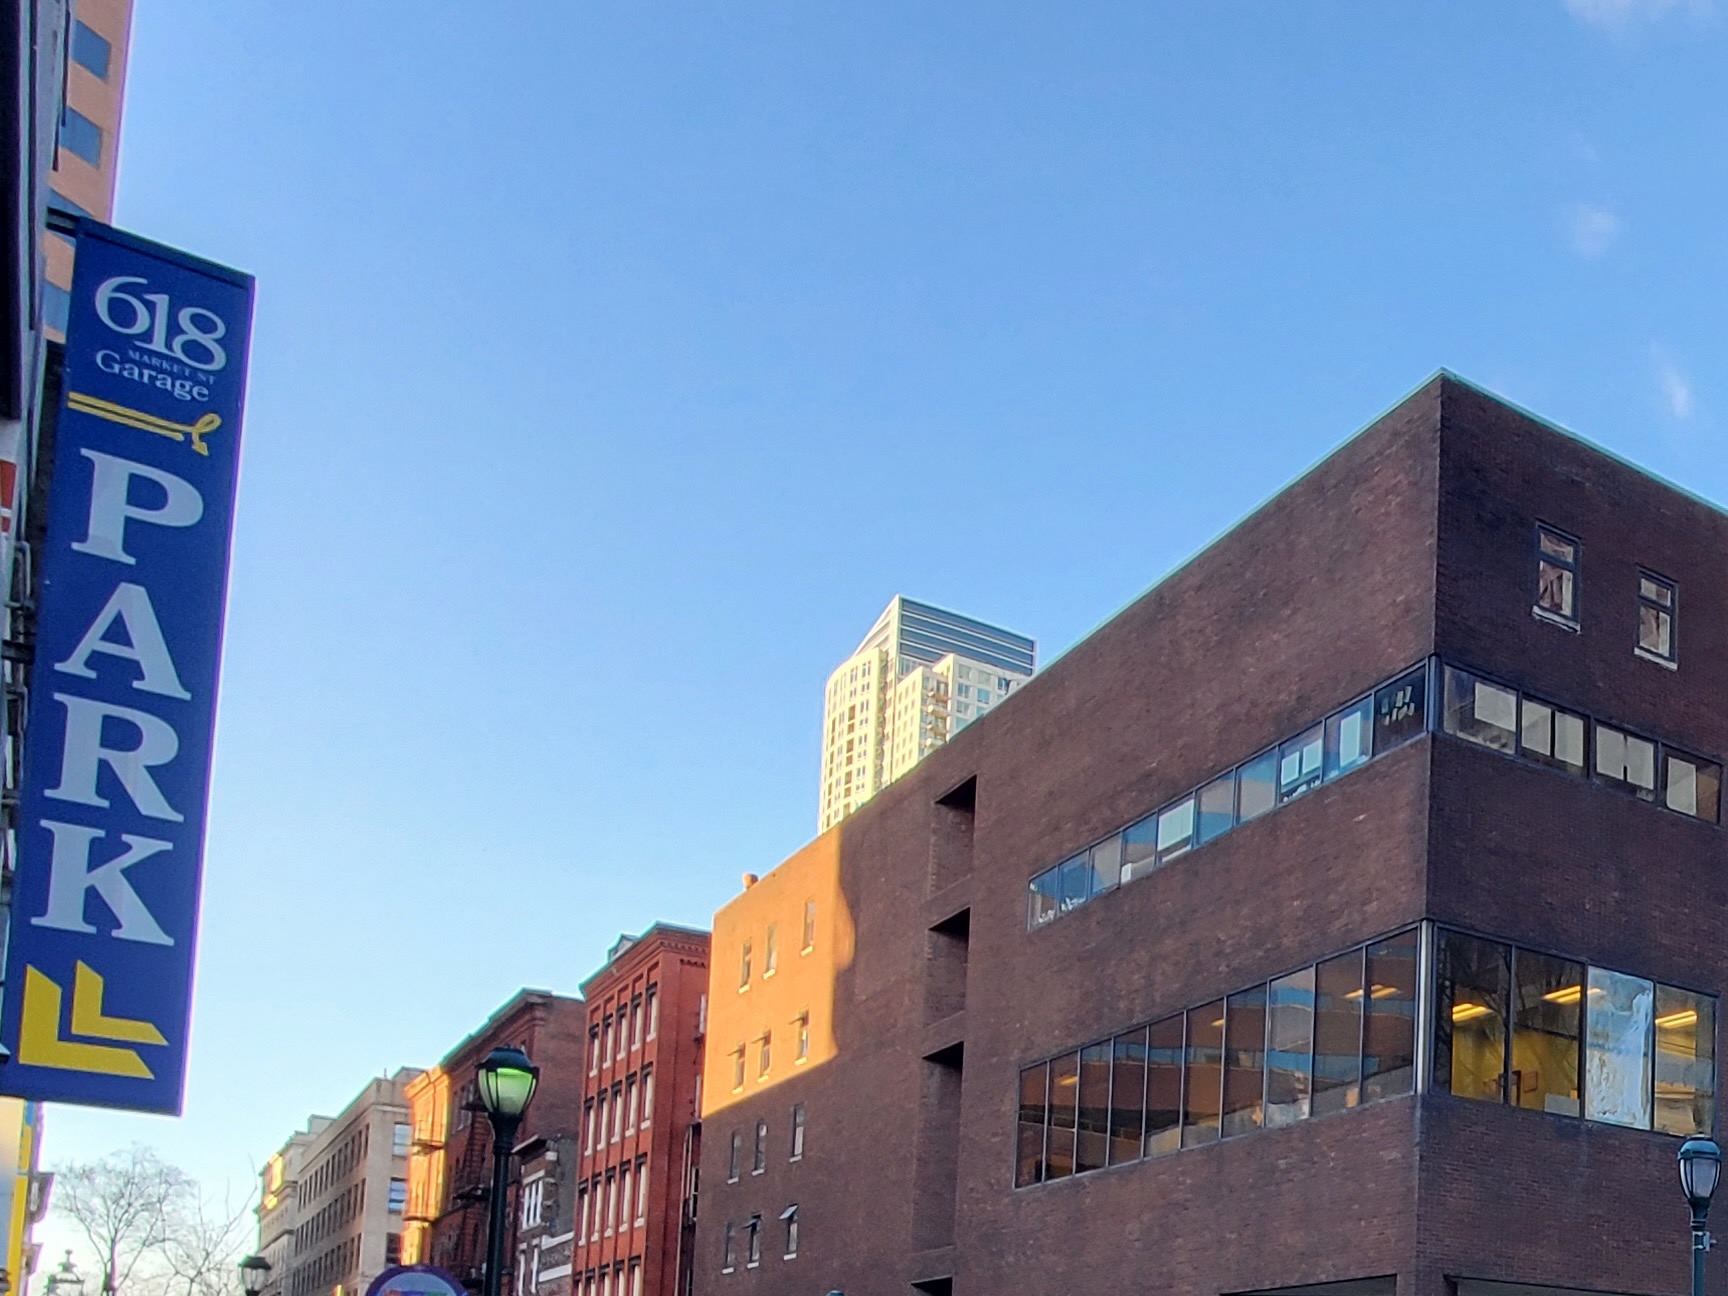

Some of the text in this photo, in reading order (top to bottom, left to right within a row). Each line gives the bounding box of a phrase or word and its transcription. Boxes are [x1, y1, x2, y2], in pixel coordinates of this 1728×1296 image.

[95, 276, 227, 371] 618
[96, 350, 209, 402] Garage
[31, 447, 203, 946] PARK
